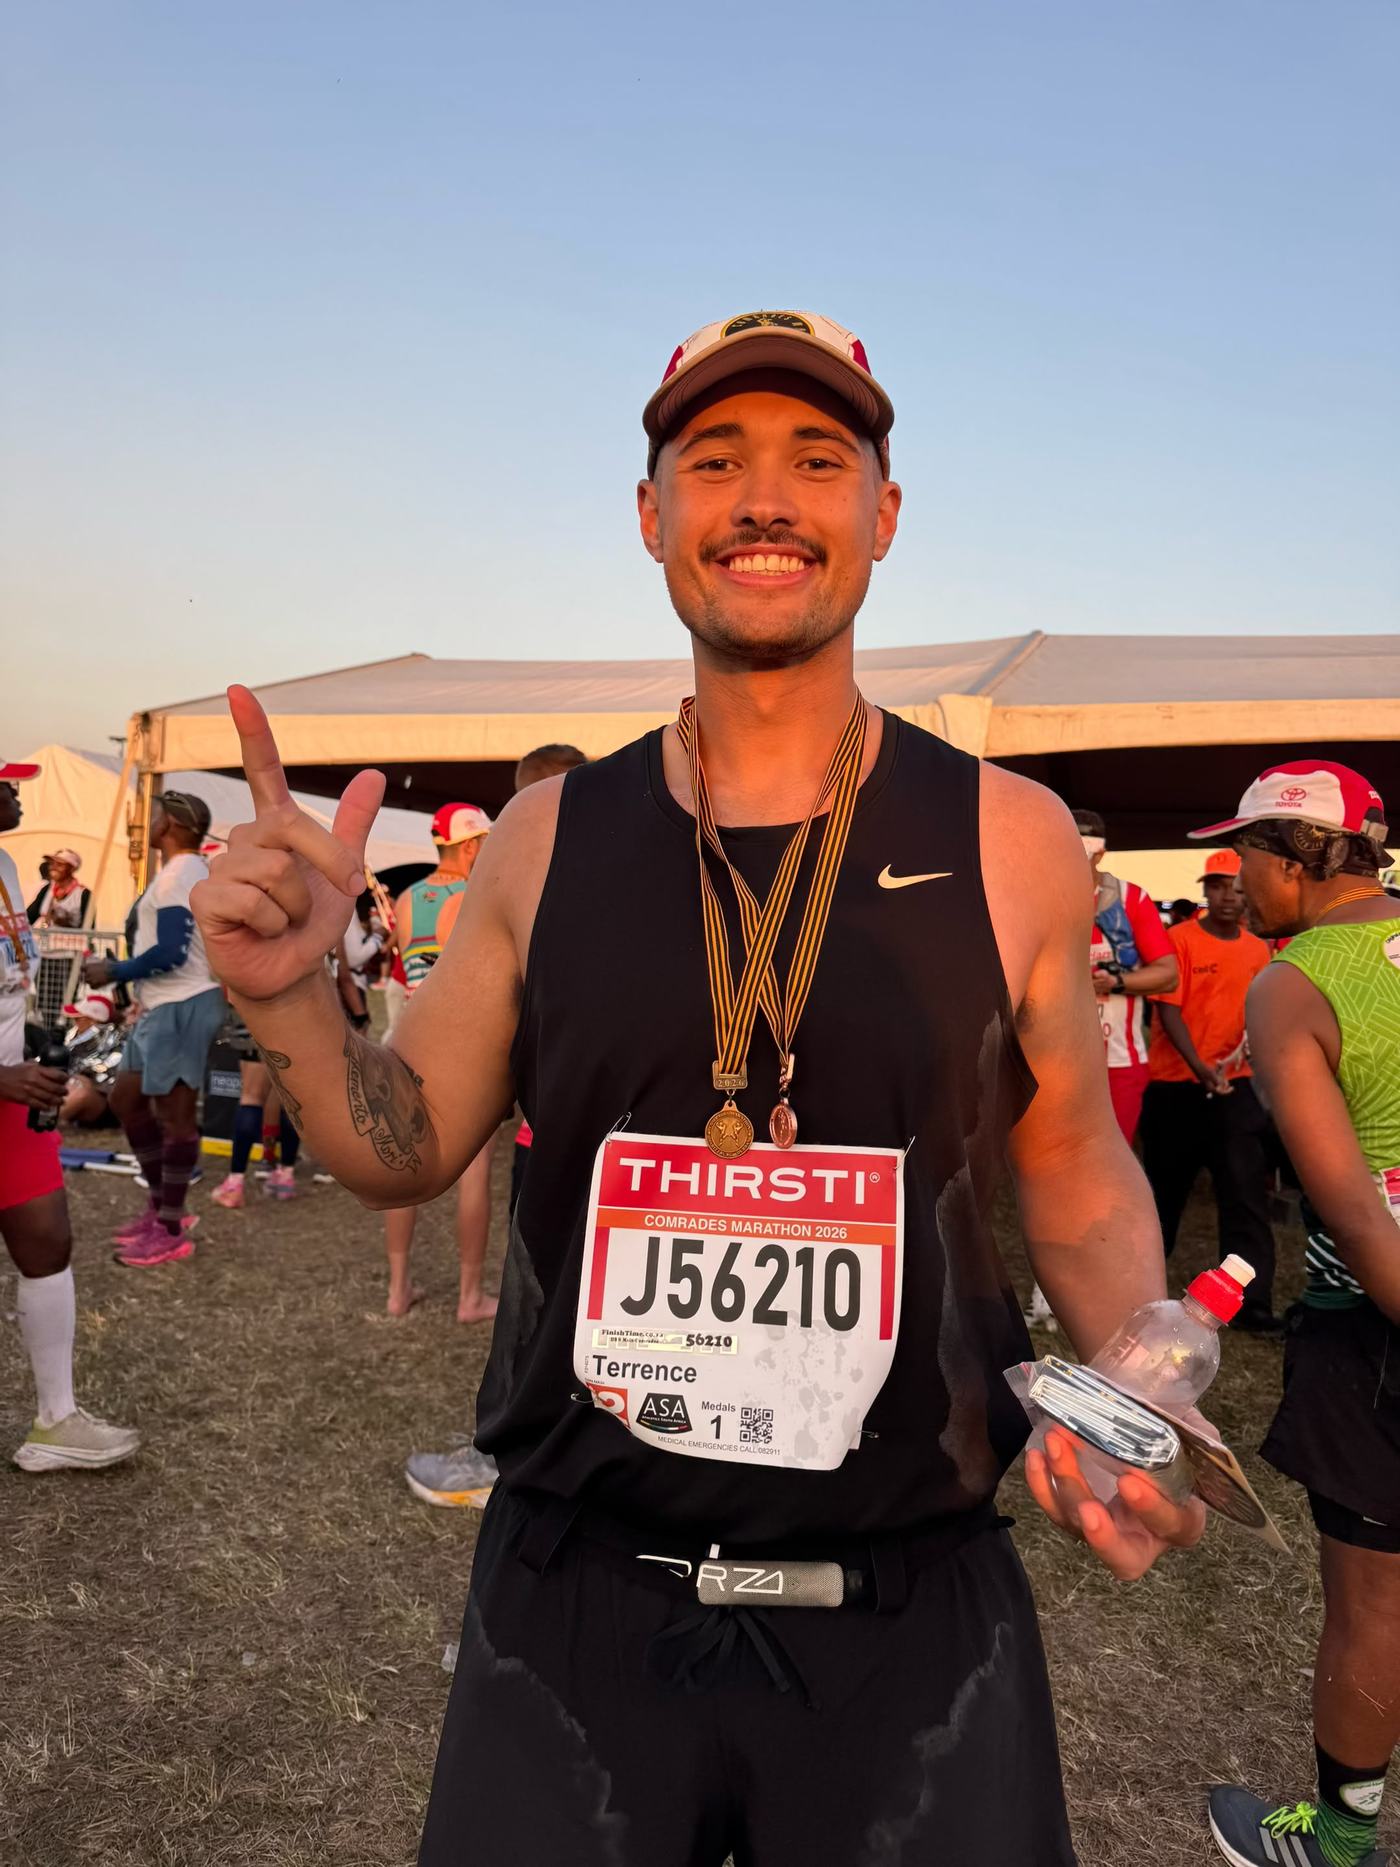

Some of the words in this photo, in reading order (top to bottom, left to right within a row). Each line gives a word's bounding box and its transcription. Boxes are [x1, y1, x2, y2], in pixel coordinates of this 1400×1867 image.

[644, 1214, 727, 1232] COMRADES
[731, 1221, 812, 1238] MARATHON
[815, 1227, 848, 1239] 2026
[619, 1236, 861, 1332] J56210
[686, 1334, 732, 1347] 56210
[592, 1354, 697, 1383] Terrence
[643, 1397, 685, 1418] ASA
[701, 1401, 736, 1412] Medals
[711, 1414, 722, 1439] 1
[658, 1436, 687, 1446] MEDICAL
[688, 1441, 738, 1452] EMERGENCIES
[740, 1445, 756, 1453] CALL
